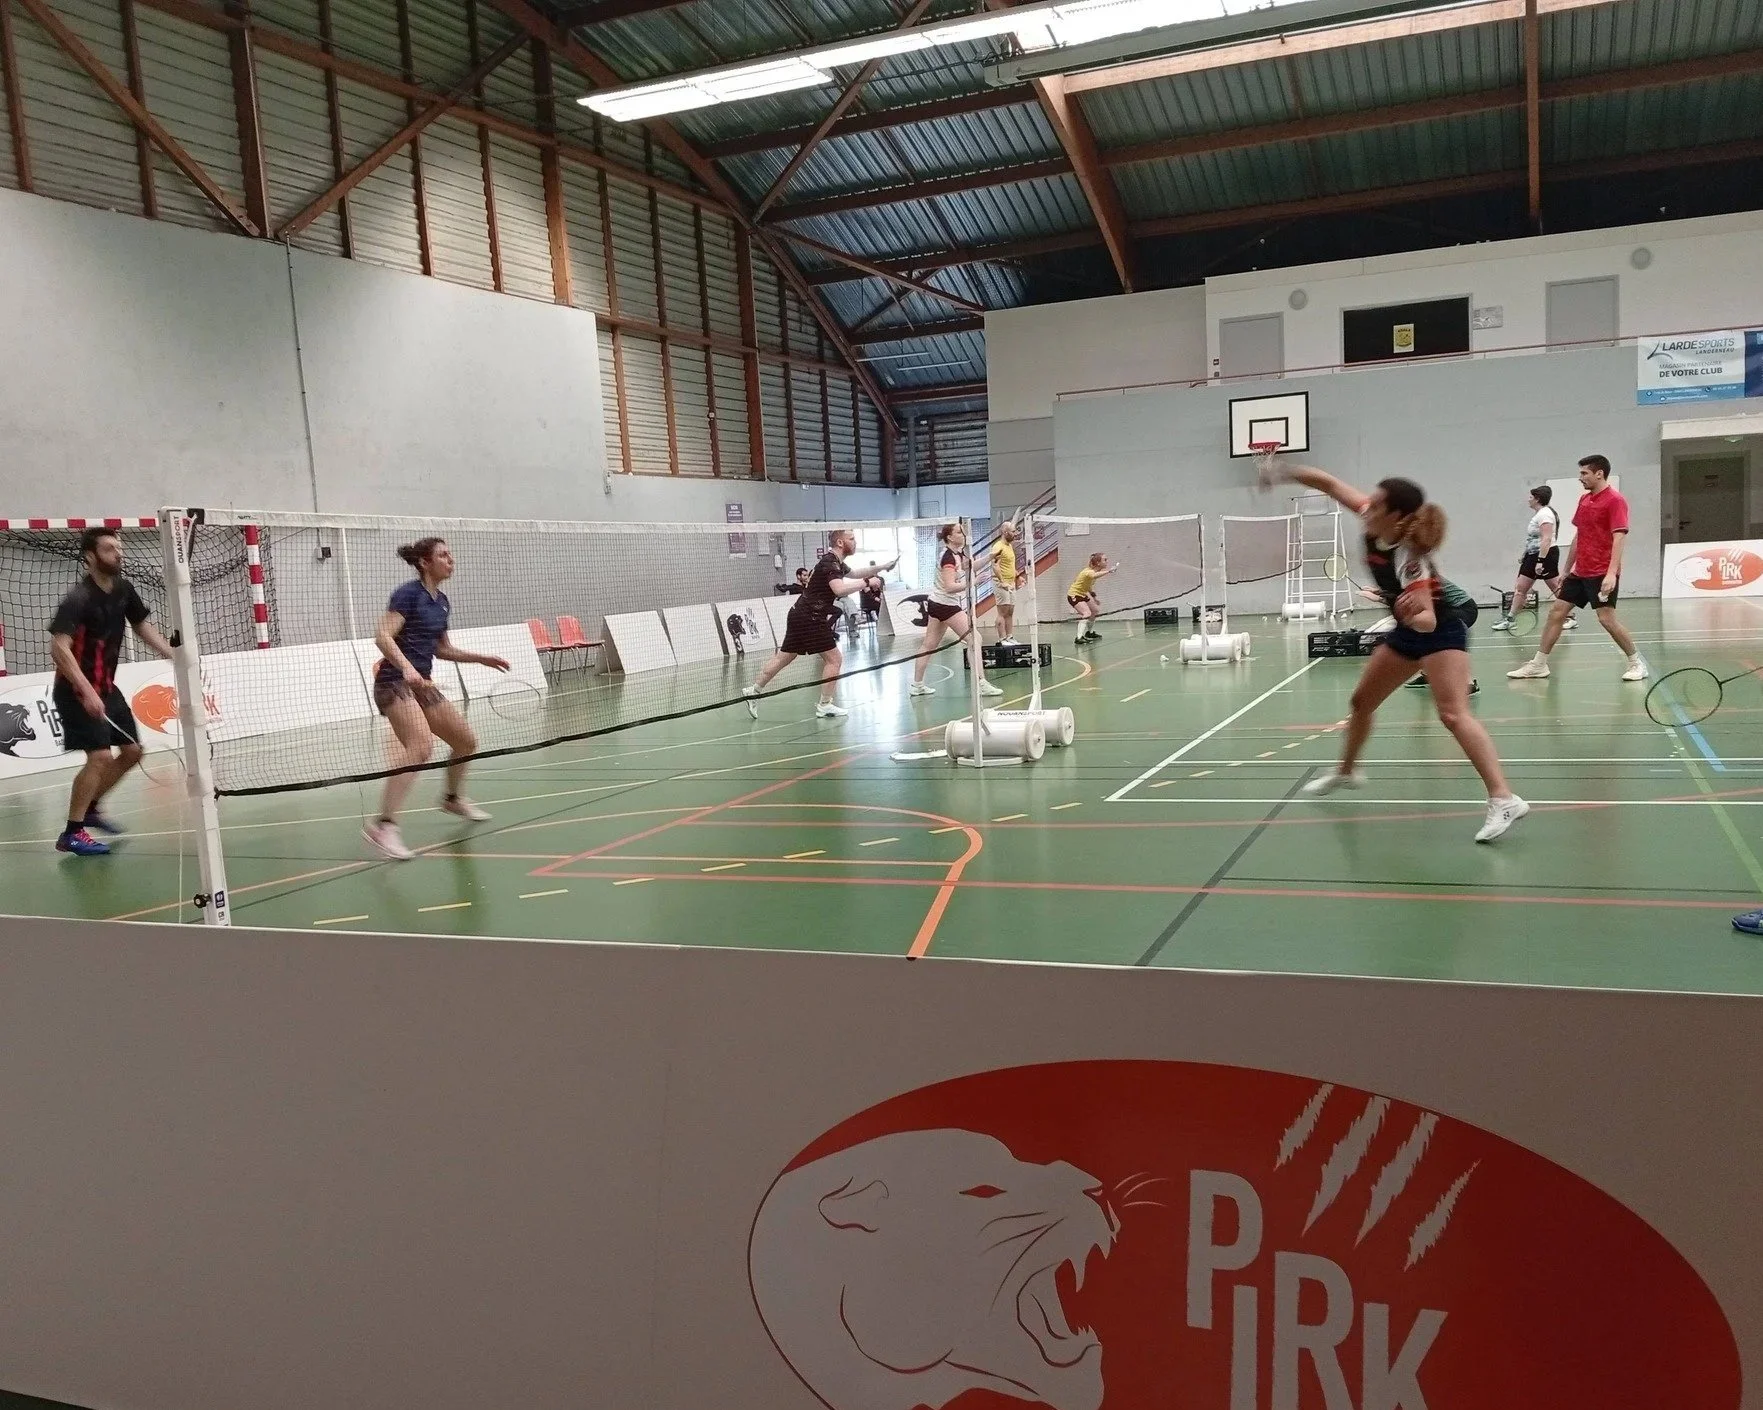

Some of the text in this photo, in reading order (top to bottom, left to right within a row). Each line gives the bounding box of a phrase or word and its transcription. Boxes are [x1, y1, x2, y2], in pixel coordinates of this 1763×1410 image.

[1659, 367, 1723, 378] DE VOTRE CLUB
